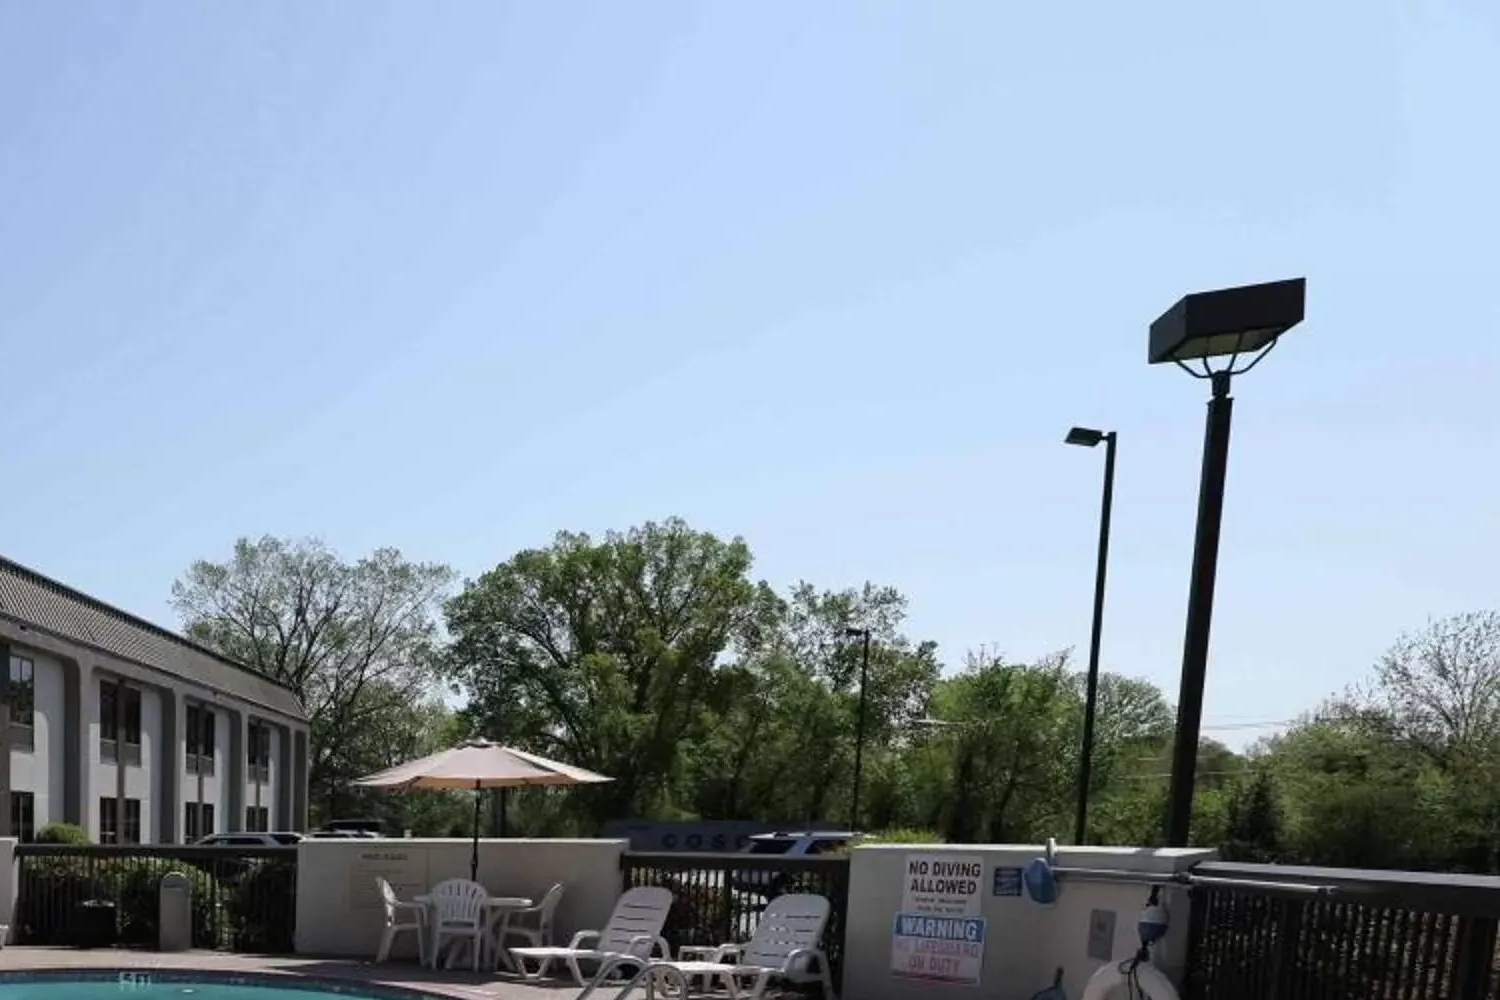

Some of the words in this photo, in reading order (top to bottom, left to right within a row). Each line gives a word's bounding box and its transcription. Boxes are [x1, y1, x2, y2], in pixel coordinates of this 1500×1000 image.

[909, 861, 929, 875] NO
[933, 862, 981, 877] DIVING
[911, 879, 977, 895] ALLOWED
[901, 917, 978, 939] WARNING
